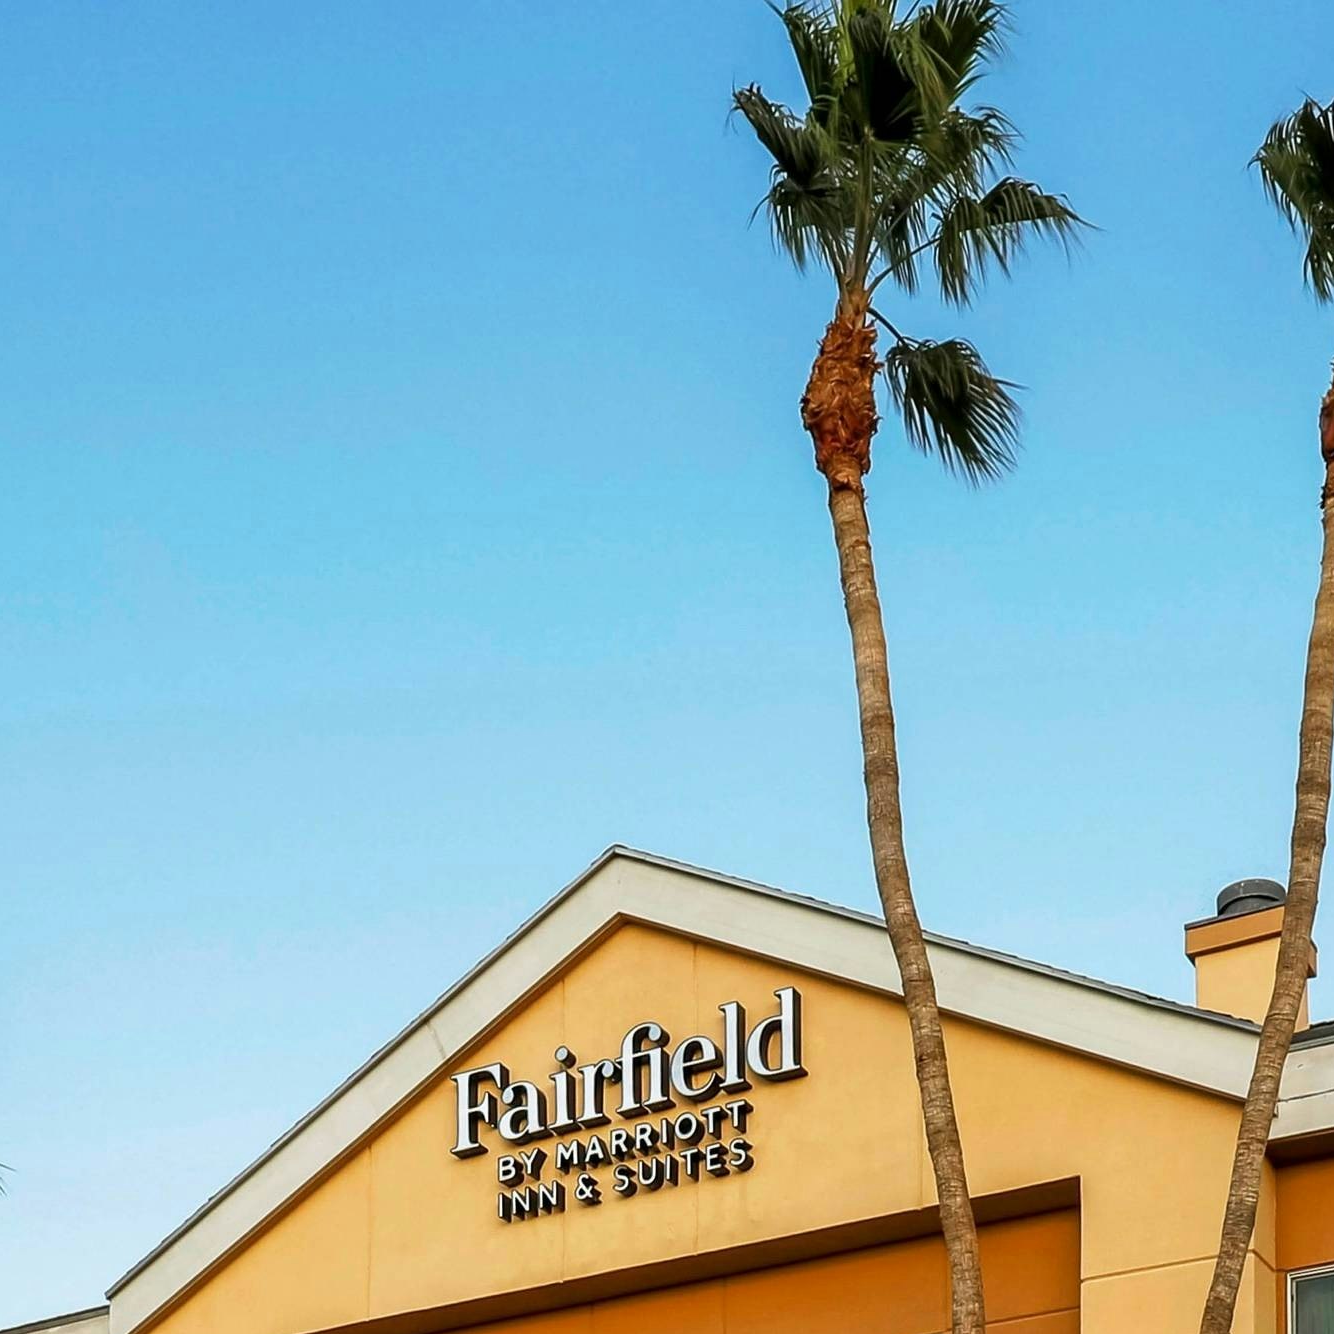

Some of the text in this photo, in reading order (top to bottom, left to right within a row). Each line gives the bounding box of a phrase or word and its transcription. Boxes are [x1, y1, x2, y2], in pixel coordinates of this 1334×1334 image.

[451, 985, 808, 1159] Fairfield
[497, 1100, 753, 1187] BY MARRIOTT
[497, 1138, 753, 1223] INN & SUITES
